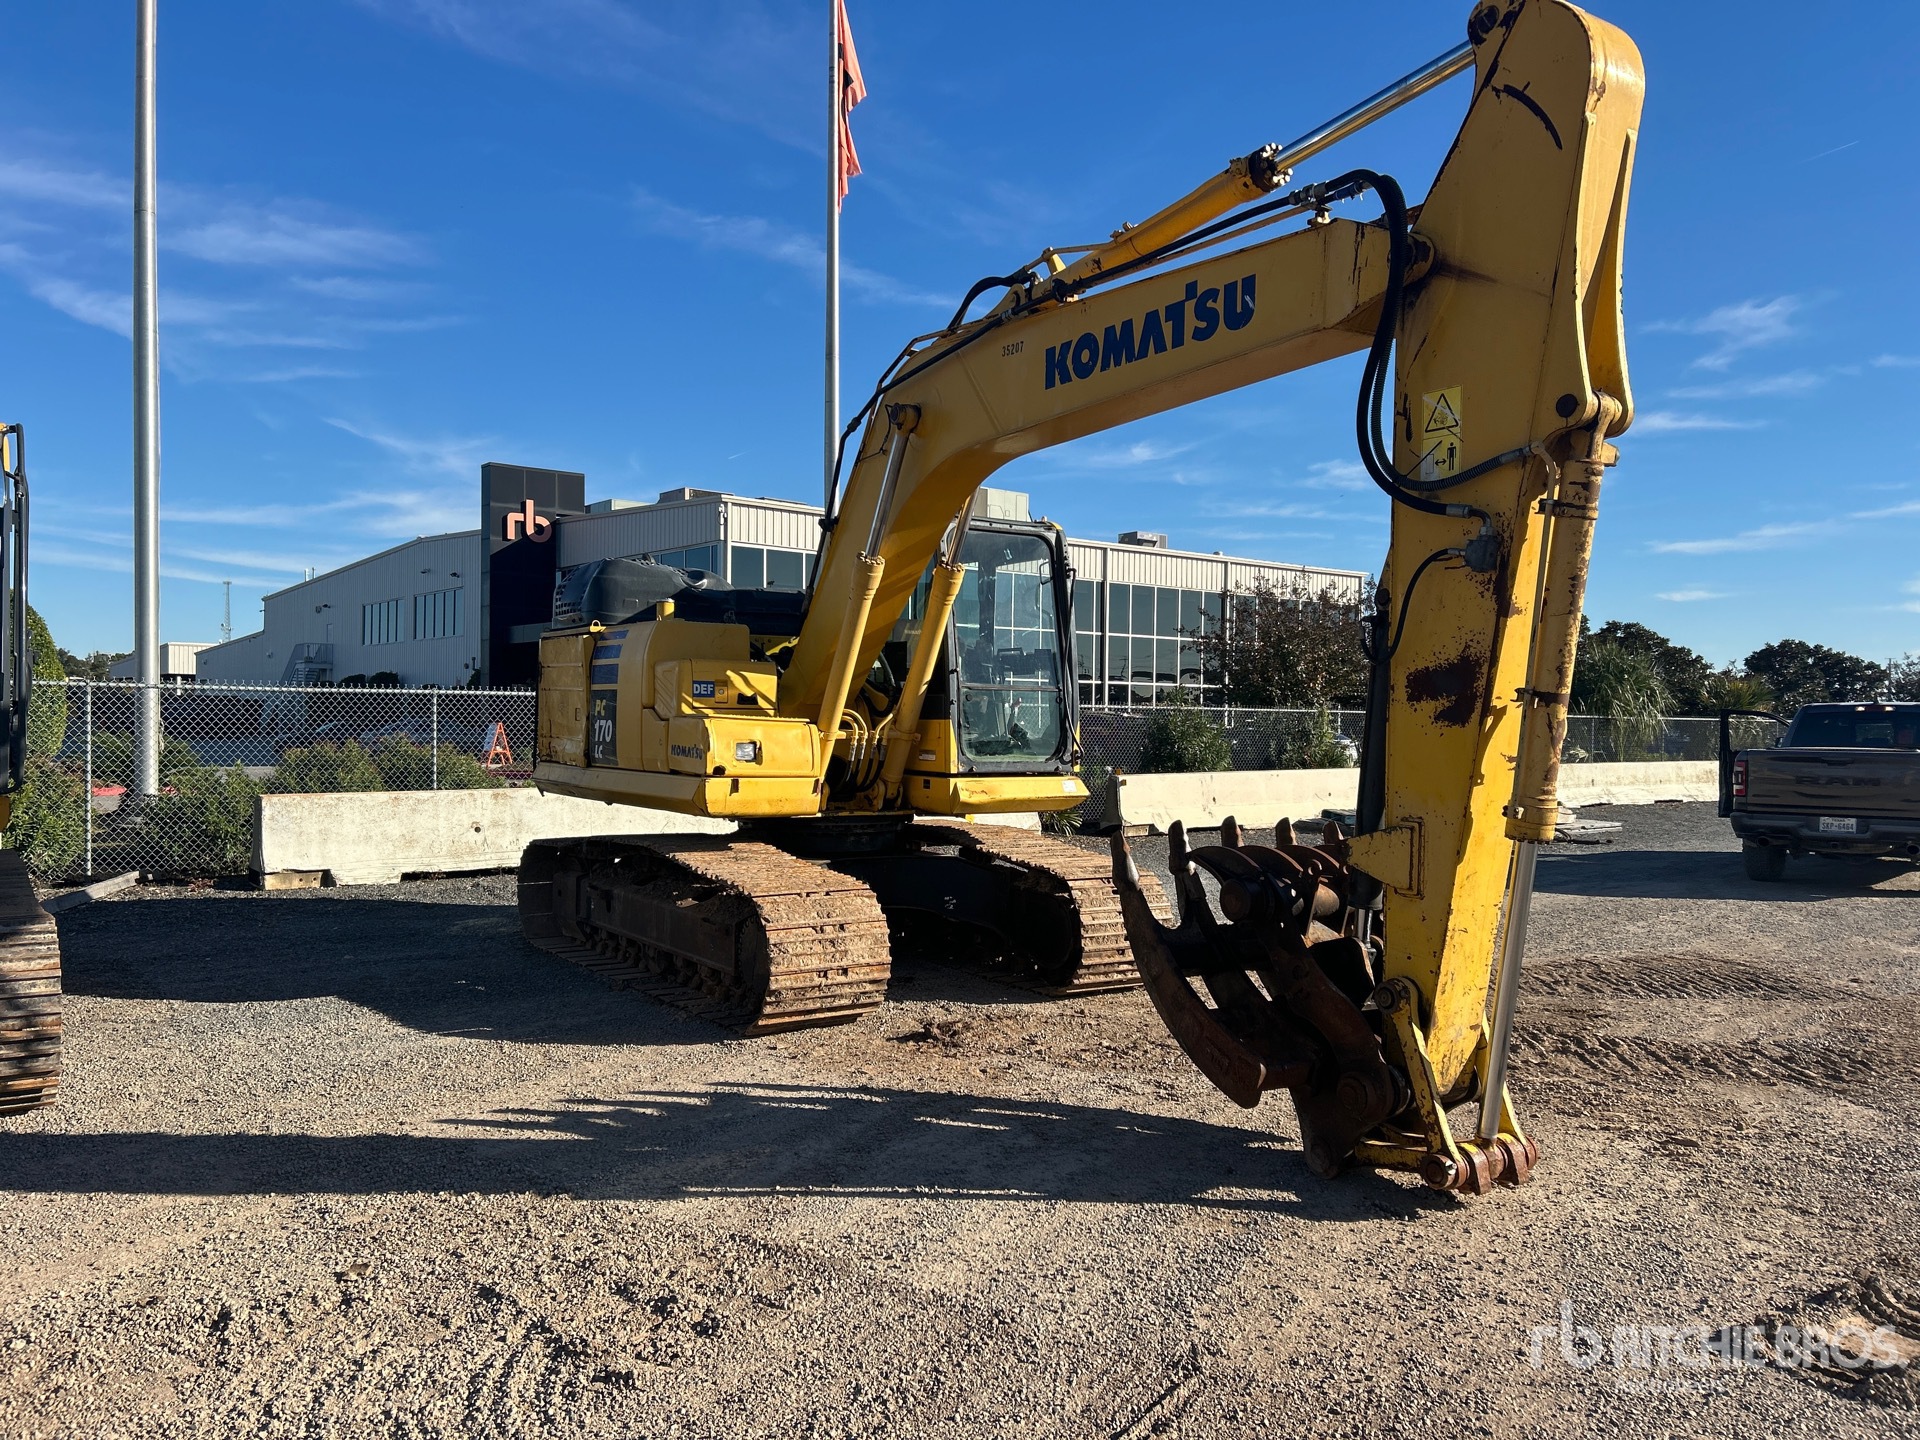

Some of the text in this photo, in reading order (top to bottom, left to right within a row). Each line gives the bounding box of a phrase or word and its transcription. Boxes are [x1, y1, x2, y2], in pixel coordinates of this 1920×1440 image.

[1001, 273, 1257, 390] 35207 KOMATSU
[507, 499, 552, 543] rb
[693, 683, 714, 695] DEF
[594, 699, 606, 716] PC
[594, 719, 612, 742] 170
[594, 744, 603, 759] LC
[671, 743, 703, 760] KOMATSU
[1795, 775, 1881, 786] RAM
